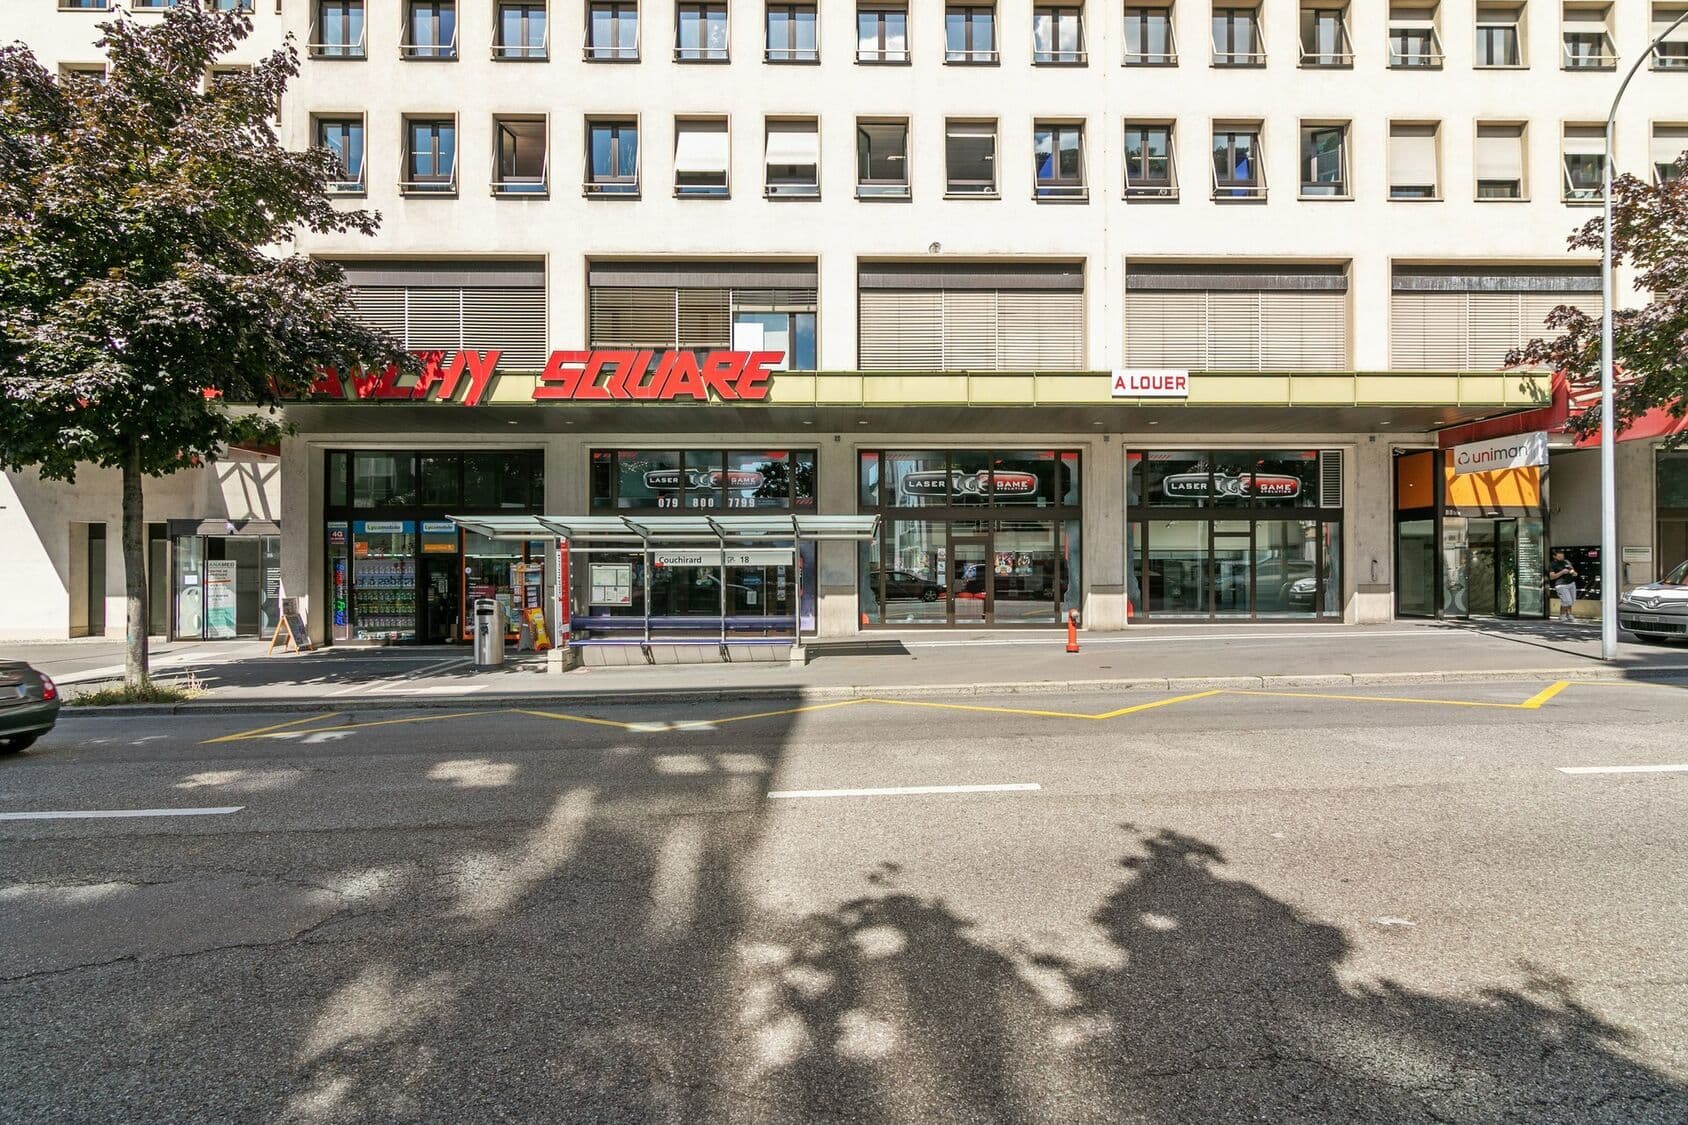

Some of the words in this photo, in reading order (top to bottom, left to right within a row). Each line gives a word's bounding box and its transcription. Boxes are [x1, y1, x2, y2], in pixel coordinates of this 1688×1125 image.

[532, 350, 785, 399] SQUARE
[1115, 375, 1126, 390] A
[1130, 375, 1186, 390] LOUER
[658, 498, 679, 508] 079
[659, 556, 702, 564] Couchirard
[741, 556, 750, 564] 18
